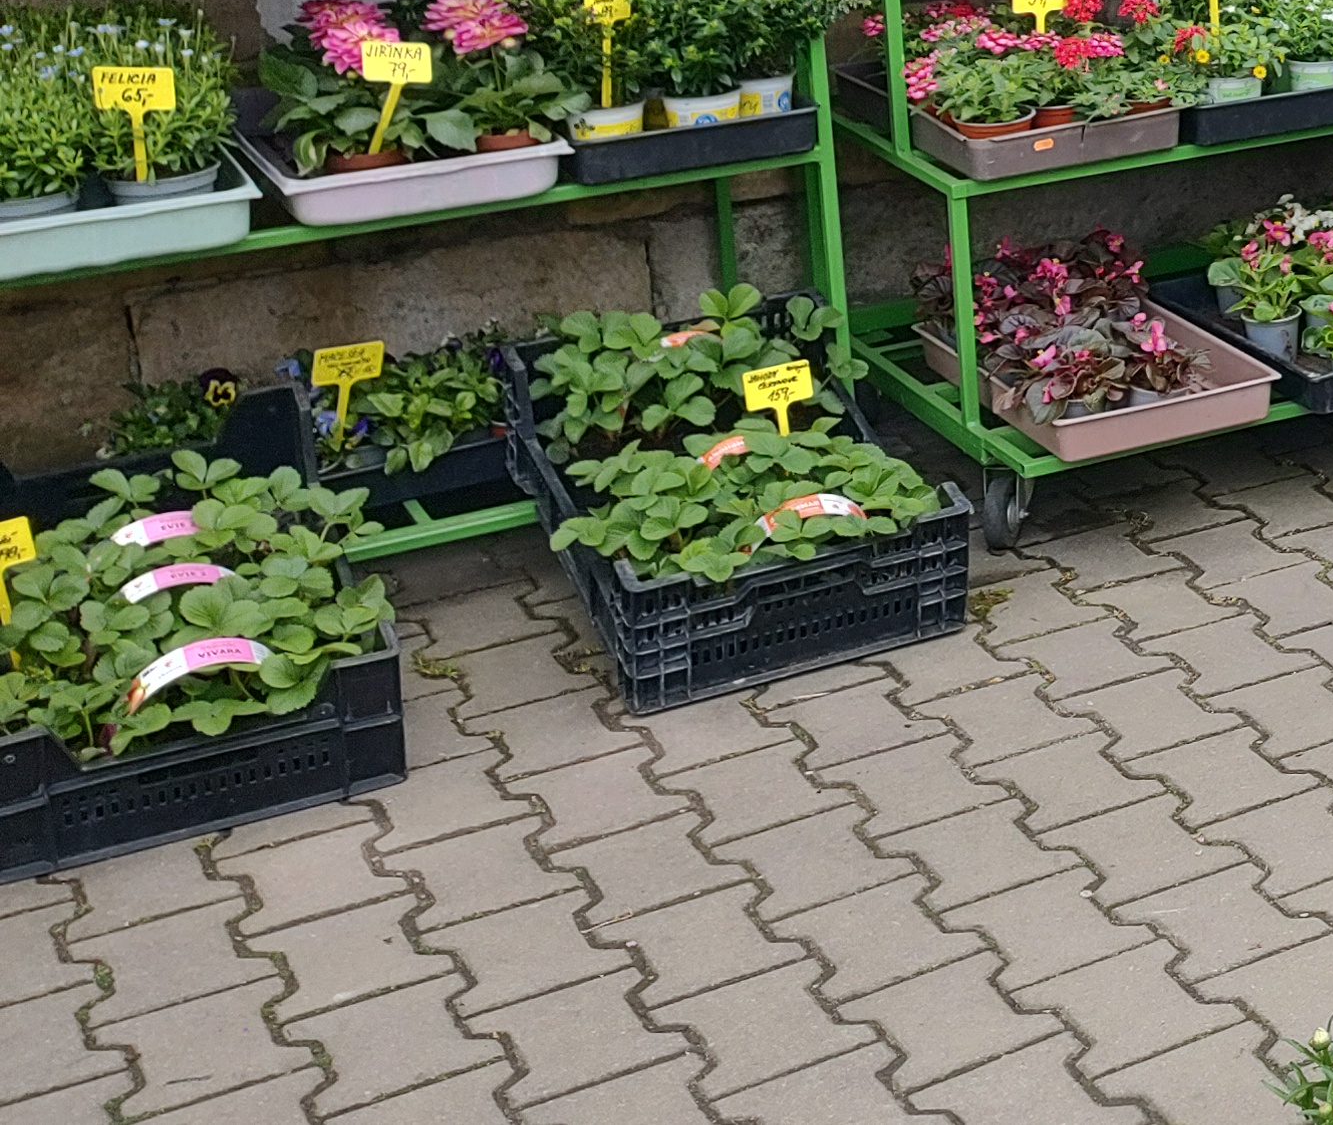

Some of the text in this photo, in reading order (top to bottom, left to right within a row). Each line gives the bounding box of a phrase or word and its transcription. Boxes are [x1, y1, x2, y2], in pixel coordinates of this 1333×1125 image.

[101, 72, 156, 85] FELICIA
[122, 88, 153, 107] 65,-
[197, 646, 243, 660] VIVARA
